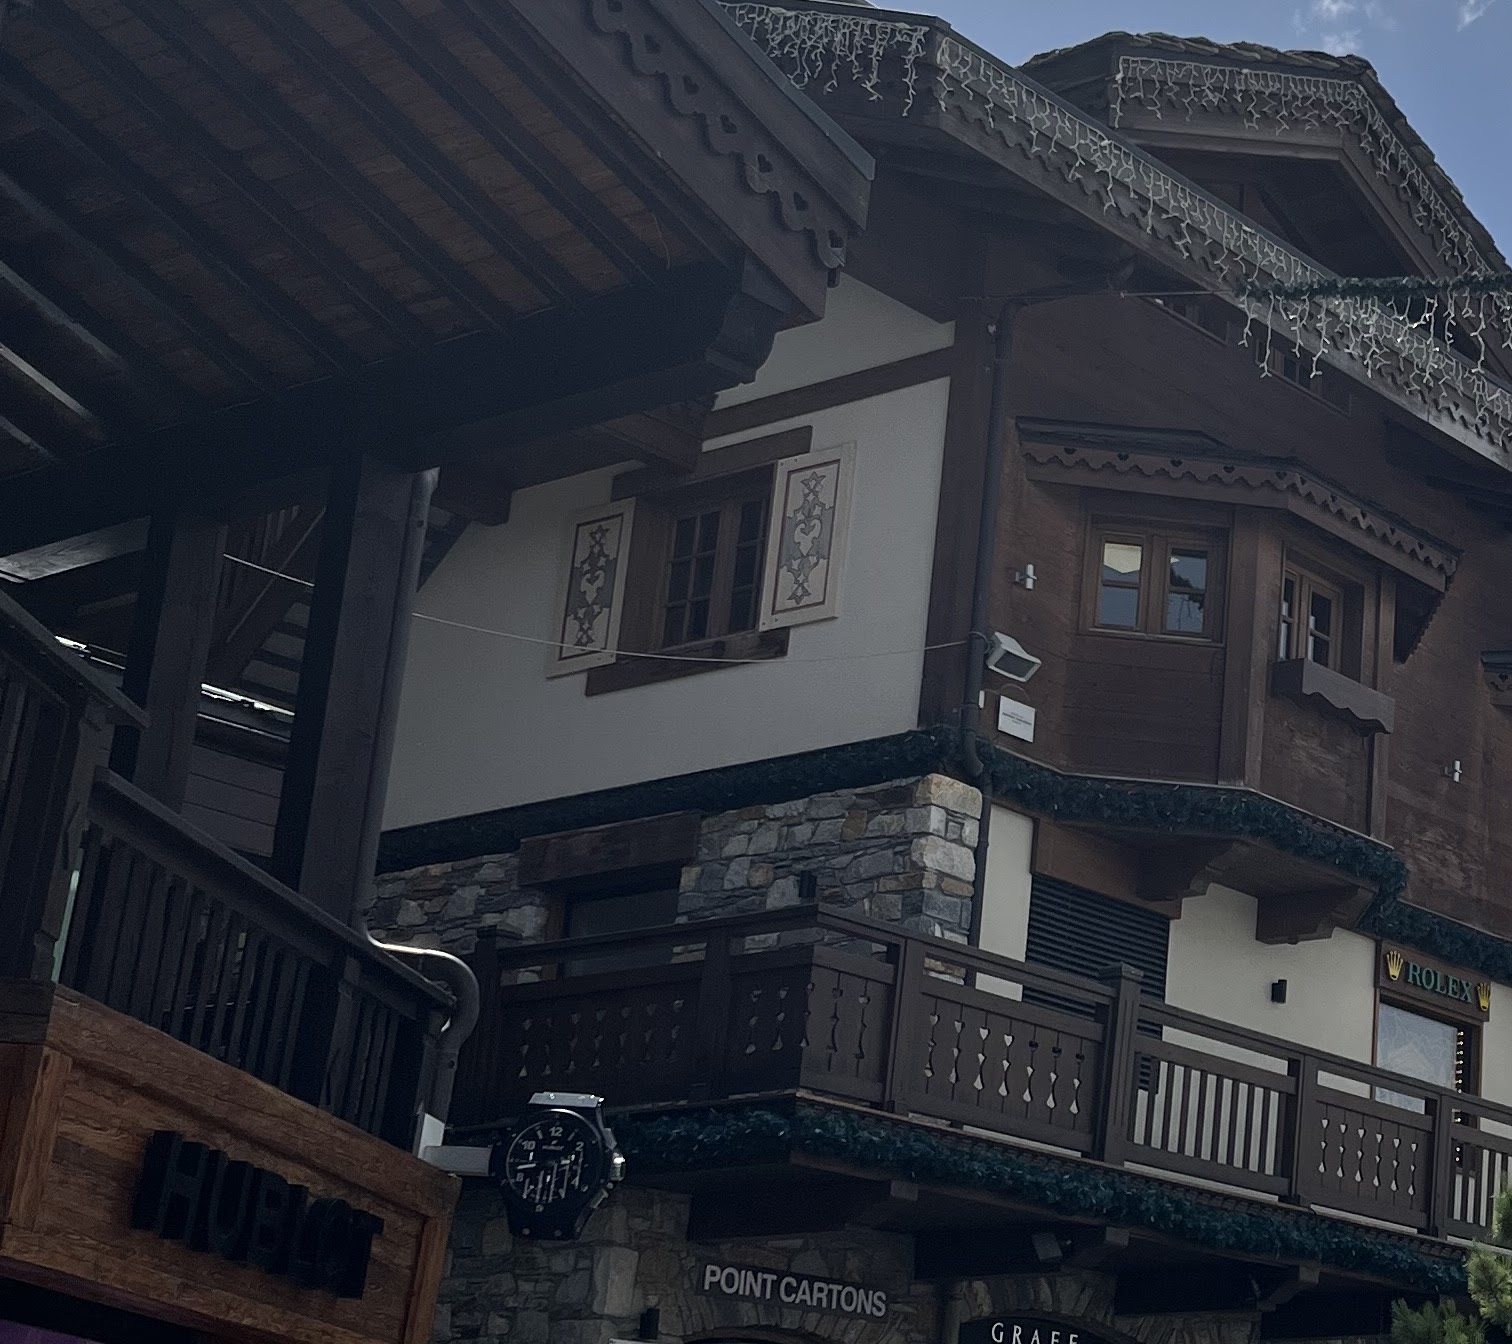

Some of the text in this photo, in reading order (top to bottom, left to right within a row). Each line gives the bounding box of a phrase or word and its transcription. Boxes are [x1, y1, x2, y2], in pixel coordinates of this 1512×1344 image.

[1407, 962, 1472, 1003] ROLEX
[522, 1140, 536, 1150] 10
[549, 1126, 563, 1137] 12
[134, 1130, 384, 1299] HUBLOT
[704, 1264, 886, 1317] POINT CARTONS
